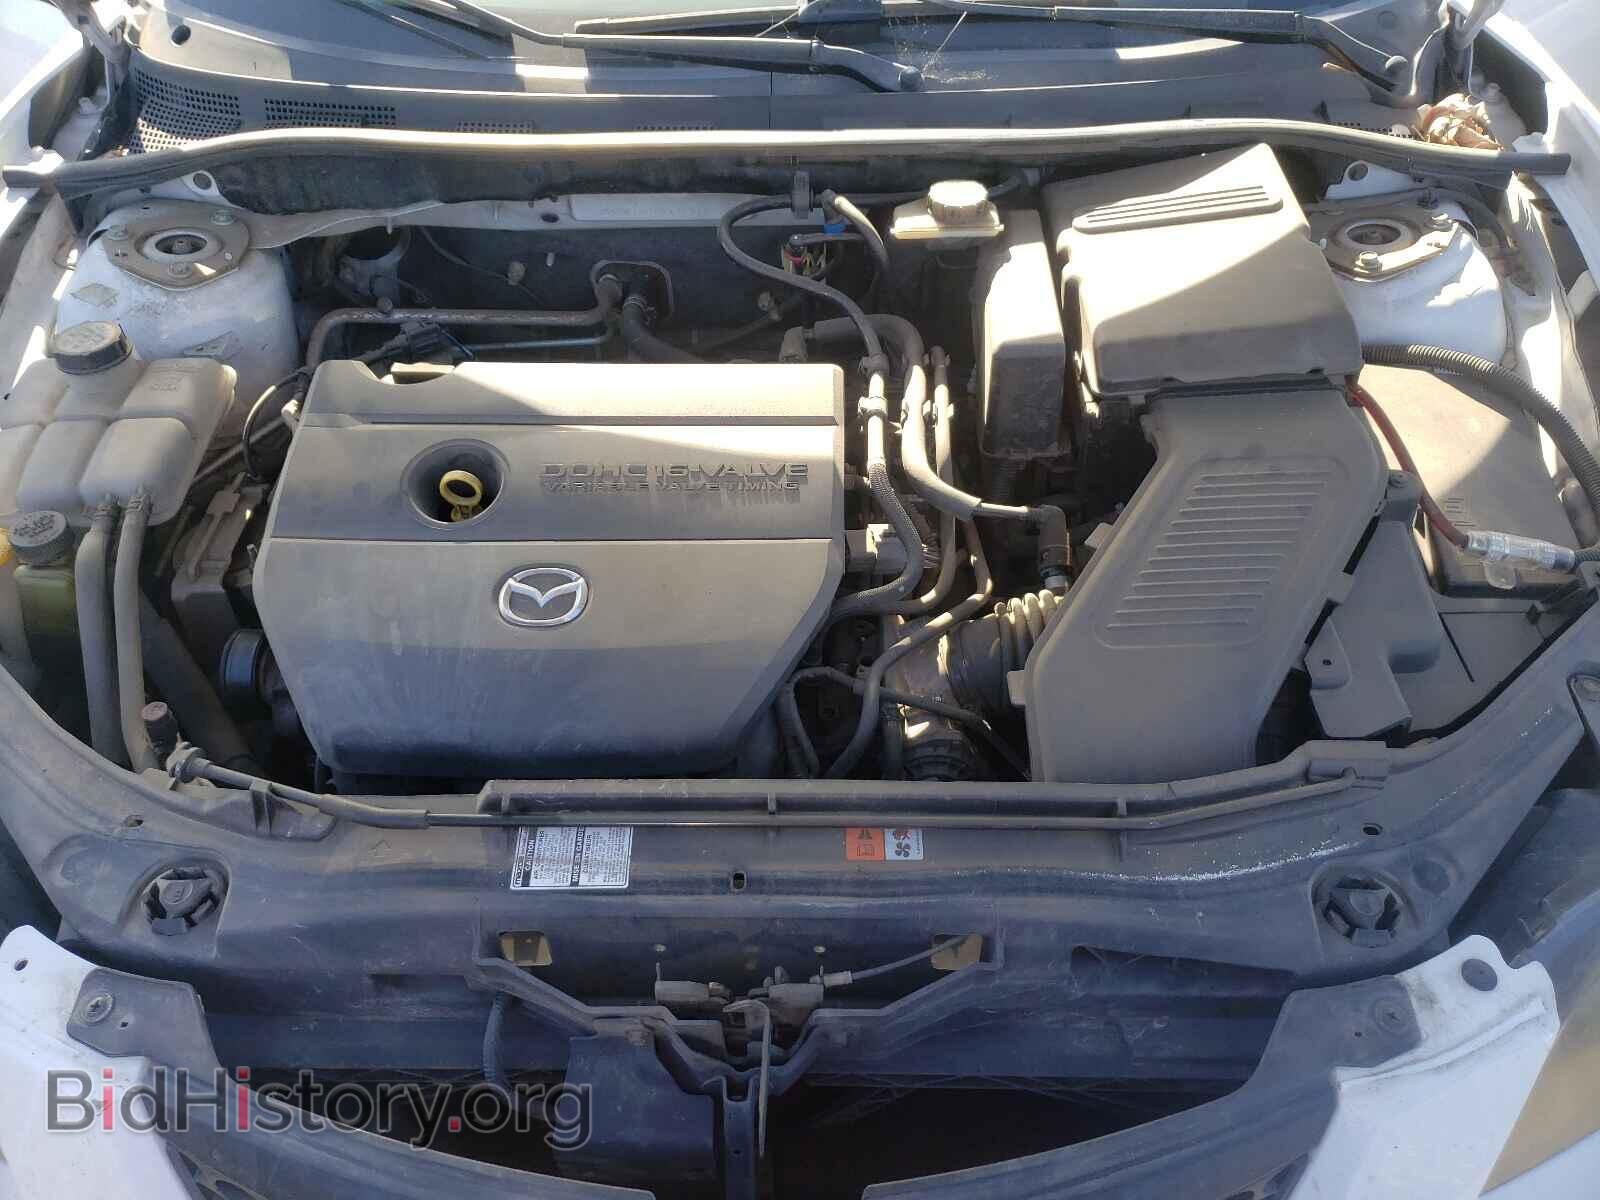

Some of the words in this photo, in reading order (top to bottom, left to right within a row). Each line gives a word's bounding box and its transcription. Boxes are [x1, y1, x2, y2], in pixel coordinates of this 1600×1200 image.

[543, 463, 648, 477] DOHC
[726, 480, 801, 491] TIMING
[524, 839, 535, 871] CAUTION
[571, 864, 581, 882] MISE
